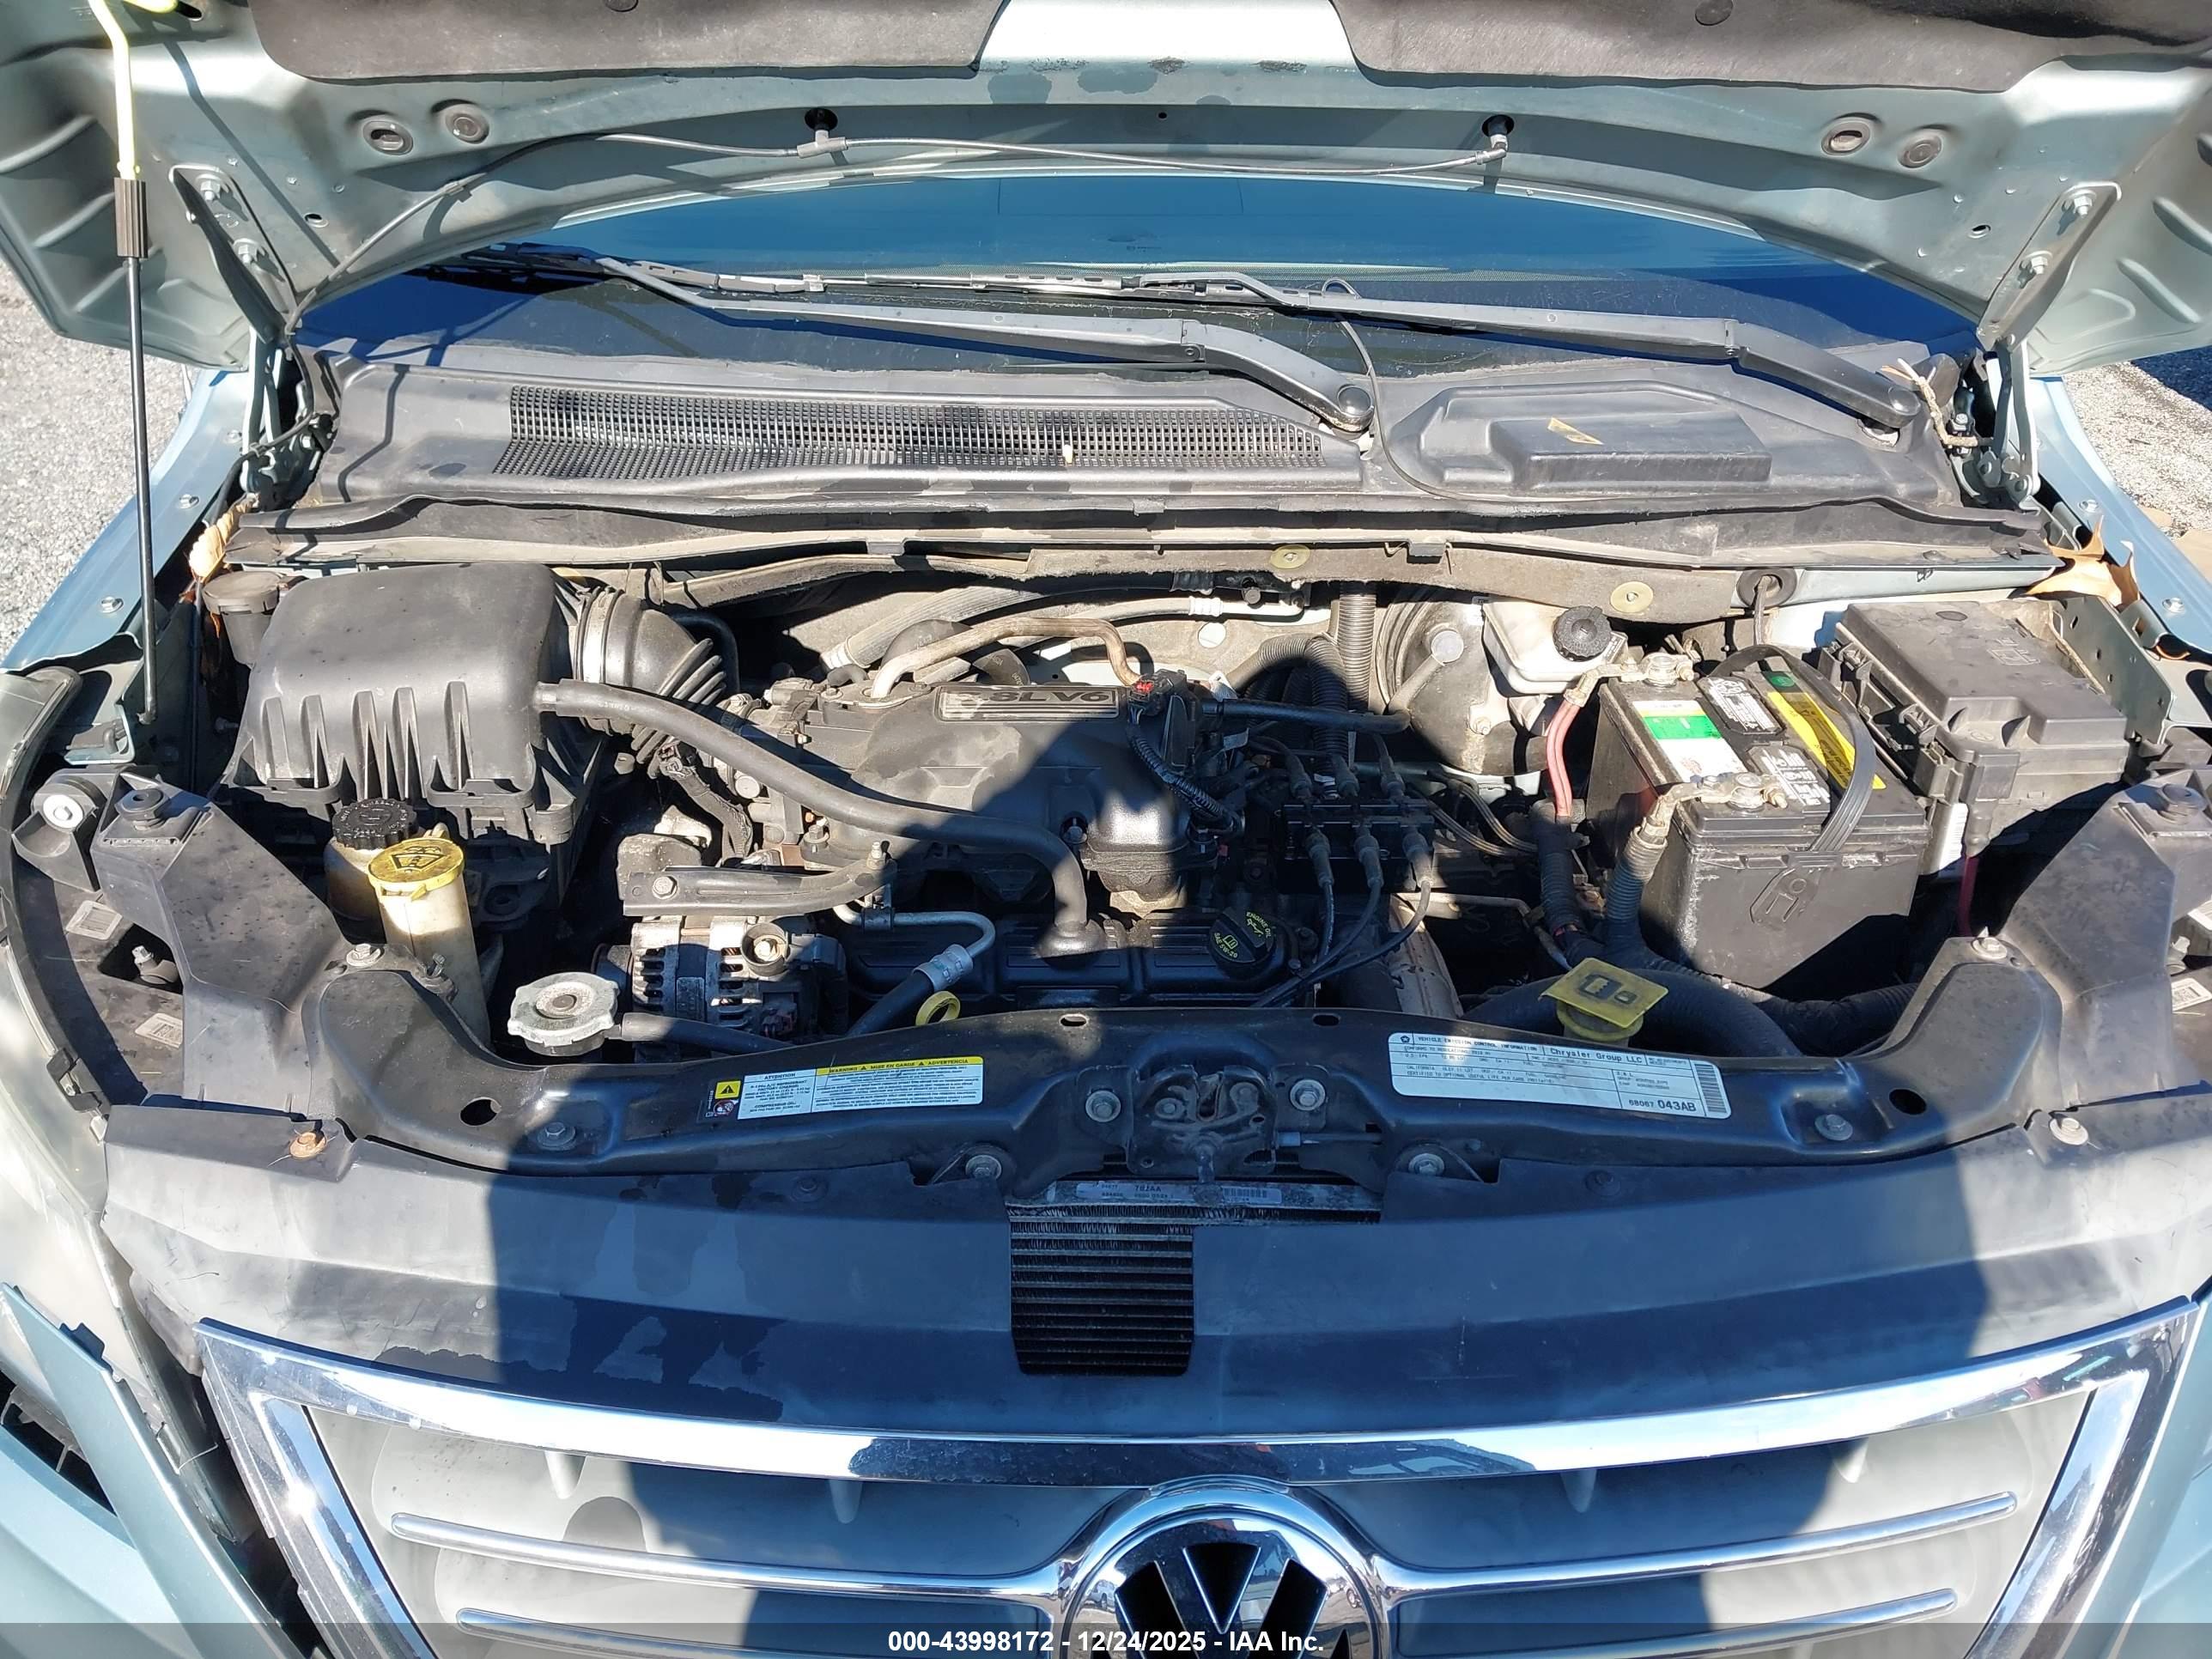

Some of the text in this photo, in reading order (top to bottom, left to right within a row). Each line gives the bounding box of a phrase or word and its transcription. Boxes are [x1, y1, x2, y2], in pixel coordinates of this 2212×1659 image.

[1246, 912, 1268, 928] ENGINE
[1213, 933, 1238, 958] SAE 5W-20
[1550, 1048, 1590, 1059] Chrysler
[1595, 1053, 1622, 1063] Group
[1657, 1100, 1697, 1112] 043AB
